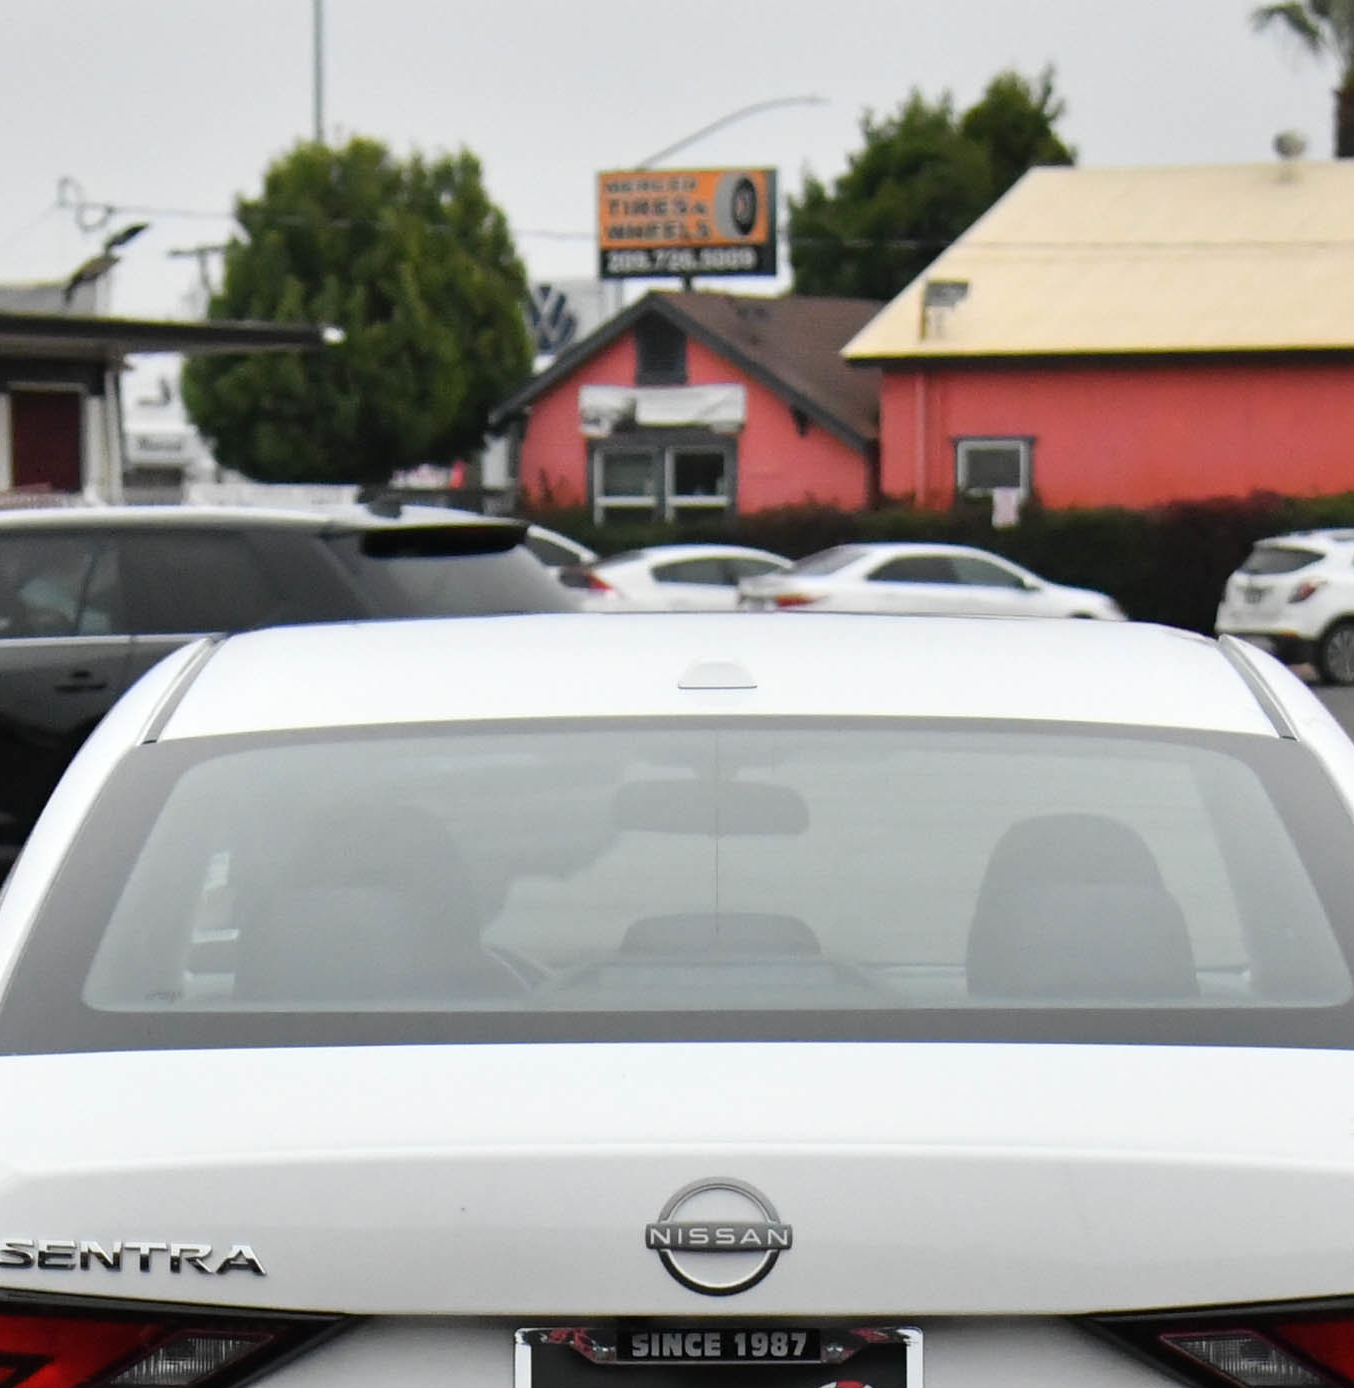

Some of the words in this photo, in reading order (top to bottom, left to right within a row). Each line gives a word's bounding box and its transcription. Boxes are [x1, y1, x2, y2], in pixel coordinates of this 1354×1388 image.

[650, 1228, 788, 1245] NISSAN
[631, 1332, 721, 1358] SINCE
[734, 1332, 807, 1358] 1987
